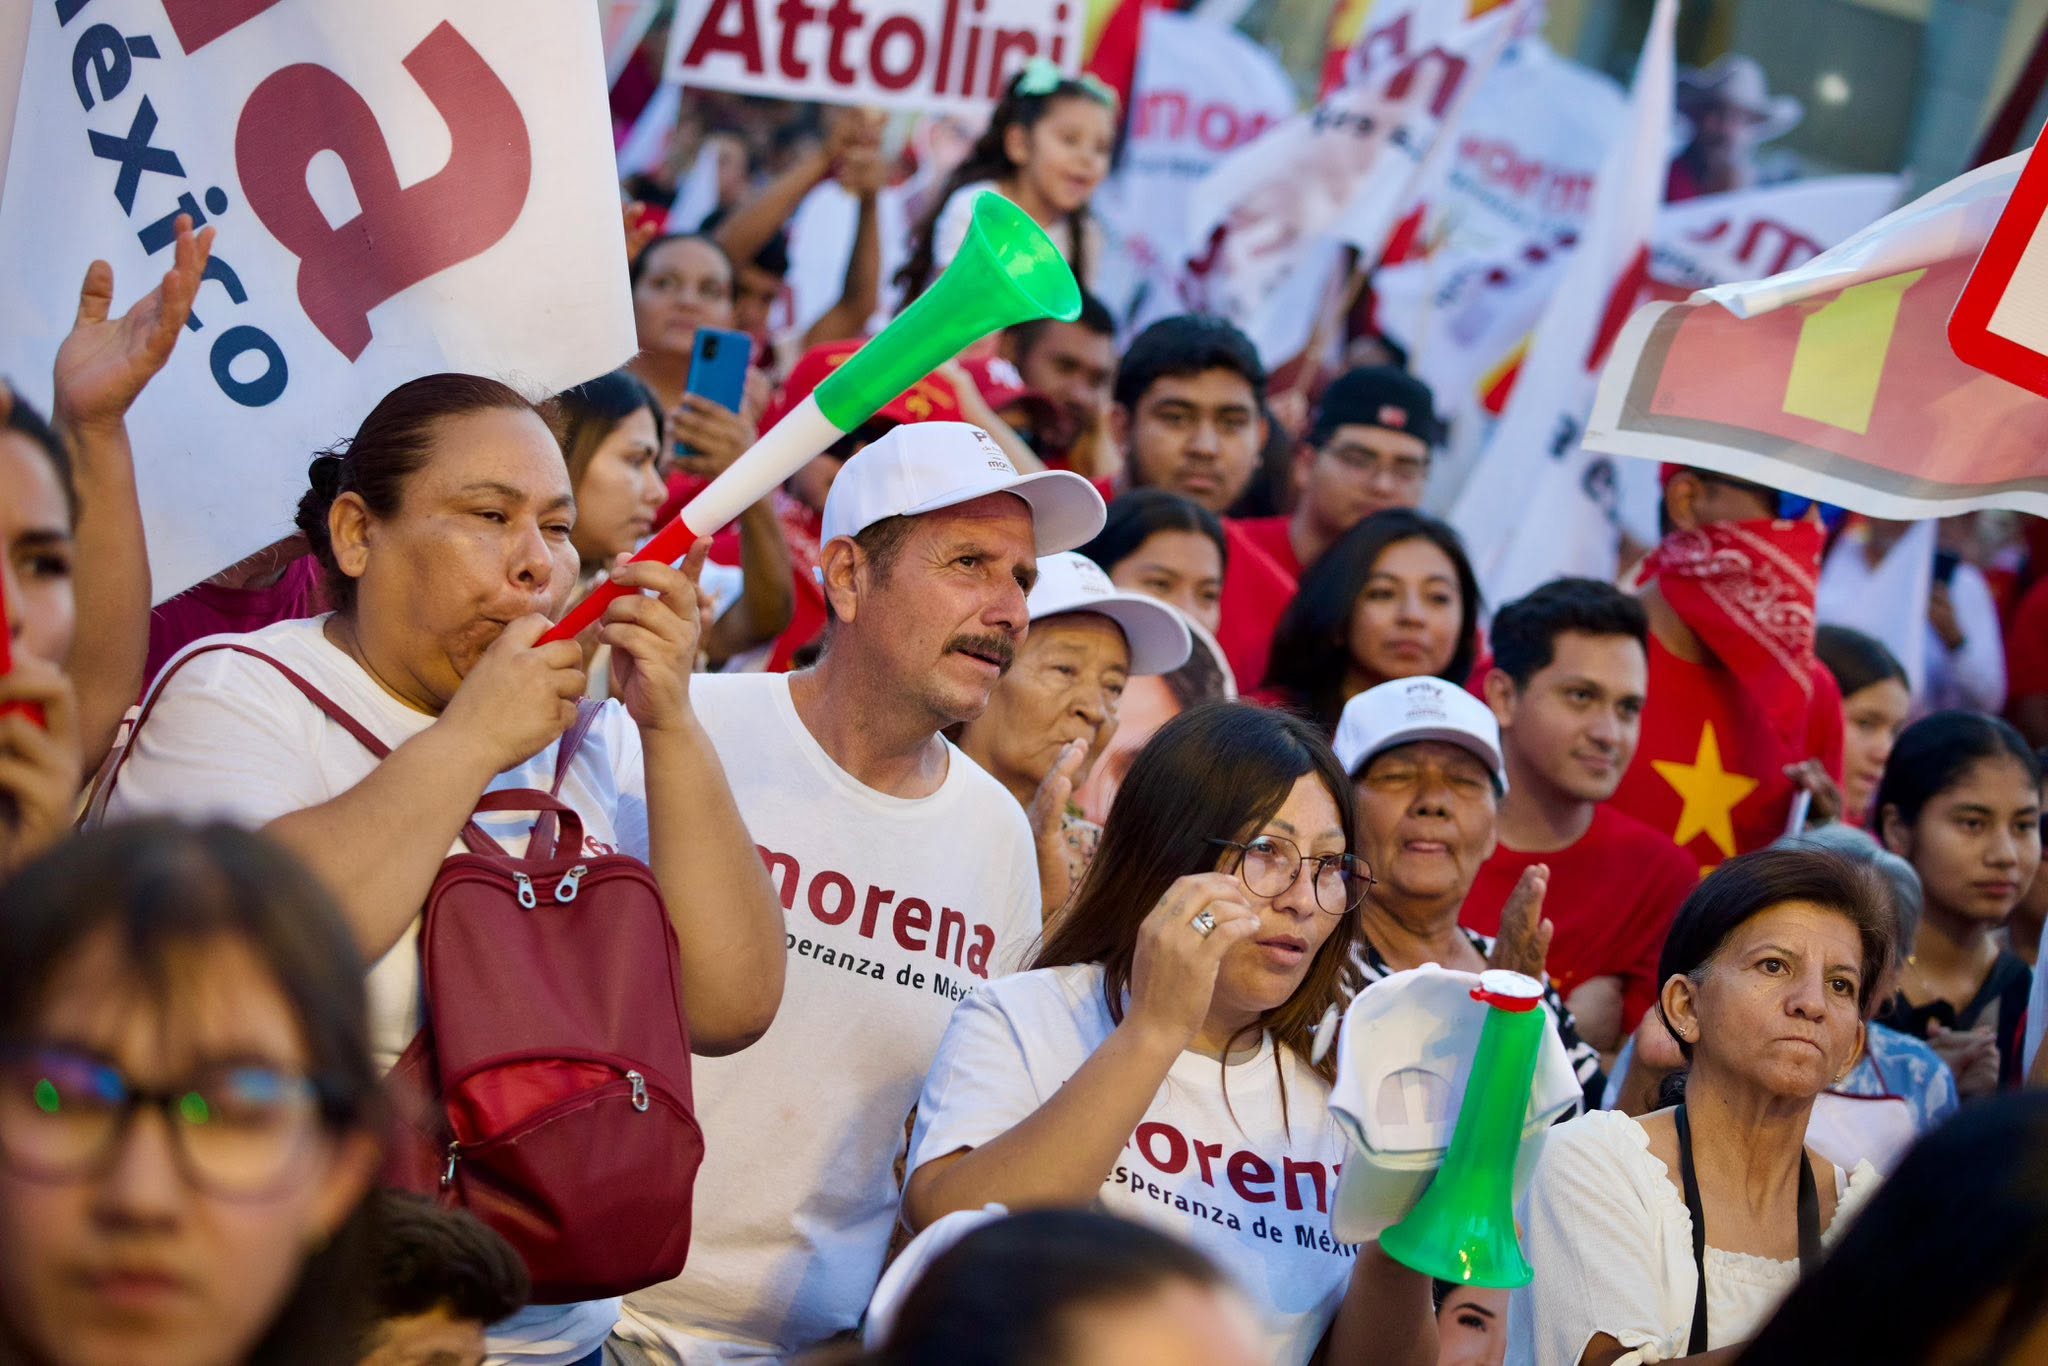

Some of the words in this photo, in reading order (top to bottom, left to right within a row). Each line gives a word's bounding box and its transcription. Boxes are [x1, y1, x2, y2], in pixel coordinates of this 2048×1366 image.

[895, 963, 925, 990] de
[933, 973, 974, 1003] Méx
[1125, 1121, 1343, 1215] oren
[1252, 1215, 1284, 1244] de
